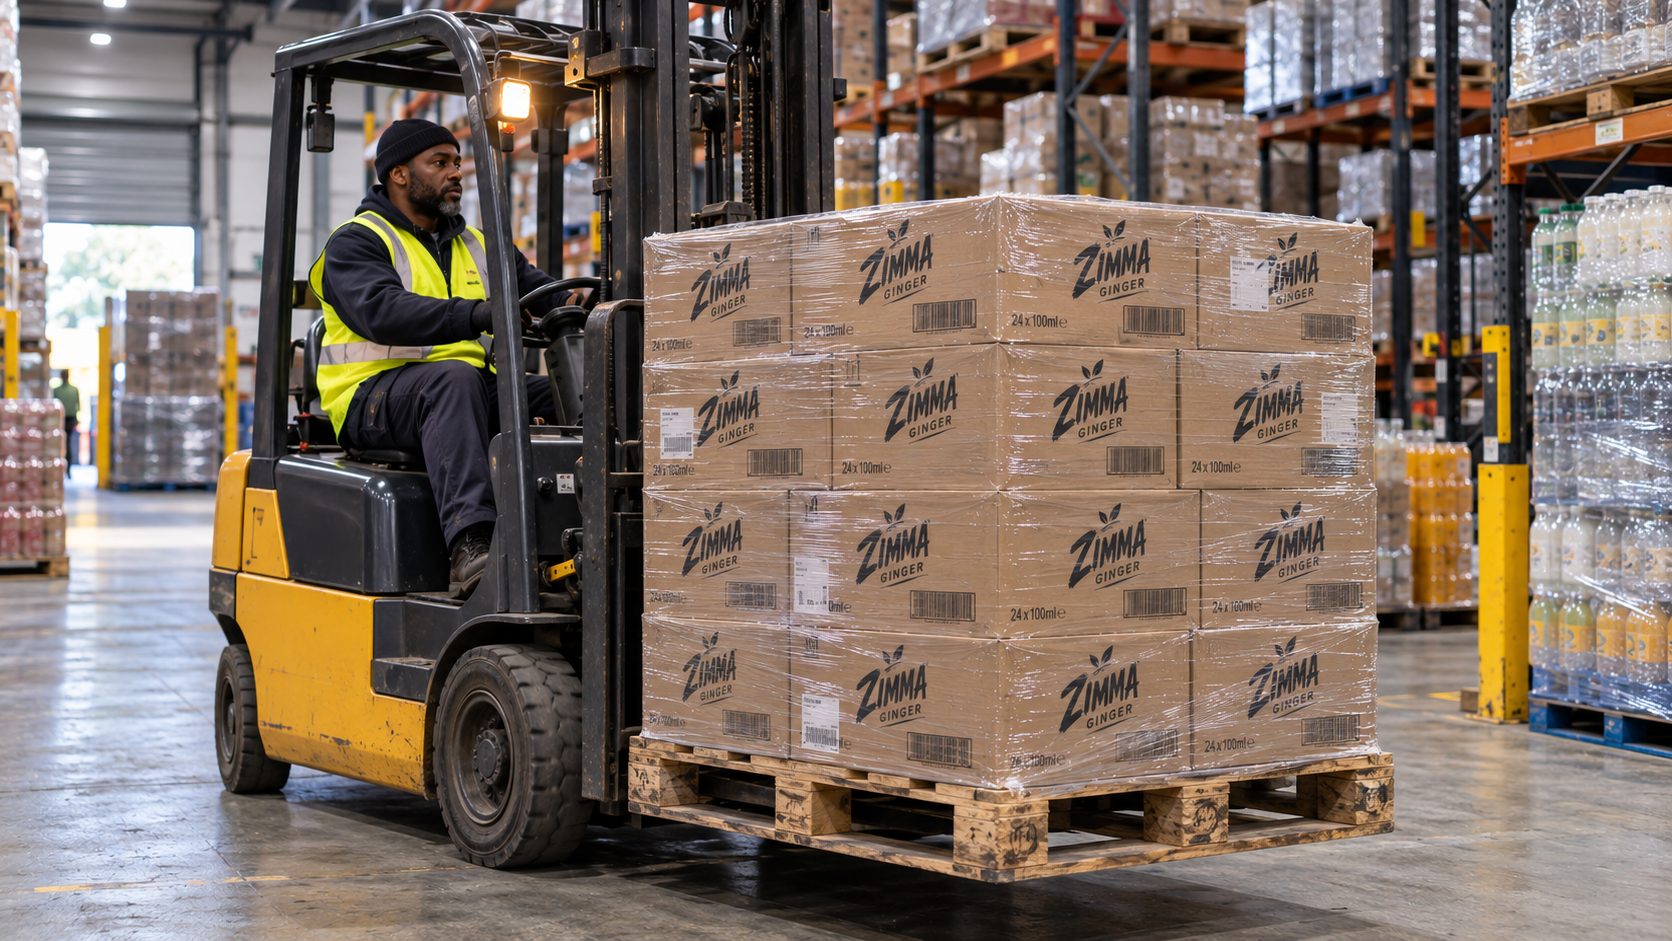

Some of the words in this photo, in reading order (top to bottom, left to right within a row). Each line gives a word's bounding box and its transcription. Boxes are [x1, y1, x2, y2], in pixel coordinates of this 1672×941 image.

[859, 234, 933, 305] ZIMMA
[884, 275, 927, 299] GINGER
[1072, 237, 1151, 300] ZIMMA
[1100, 278, 1144, 297] GINGER
[690, 256, 751, 322] ZIMMA
[711, 294, 746, 317] GINGER
[1276, 287, 1314, 305] GINGER
[697, 386, 760, 447] ZIMMA
[884, 373, 959, 442] ZIMMA
[909, 415, 952, 438] GINGER
[1052, 376, 1128, 442] ZIMMA
[1232, 380, 1304, 443] ZIMMA
[718, 422, 755, 443] GINGER
[1078, 417, 1122, 438] GINGER
[1257, 419, 1298, 439] GINGER
[681, 518, 743, 577] ZIMMA
[702, 555, 738, 574] GINGER
[856, 521, 930, 585] ZIMMA
[1068, 519, 1146, 589] ZIMMA
[1254, 516, 1325, 582] ZIMMA
[881, 562, 924, 583] GINGER
[1095, 561, 1140, 584] GINGER
[1278, 557, 1319, 578] GINGER
[682, 650, 737, 702] ZIMMA
[856, 663, 927, 723] ZIMMA
[1248, 652, 1319, 718] ZIMMA
[880, 704, 922, 722] GINGER
[1059, 661, 1140, 734] ZIMMA
[1087, 703, 1133, 729] GINGER
[1273, 691, 1314, 713] GINGER
